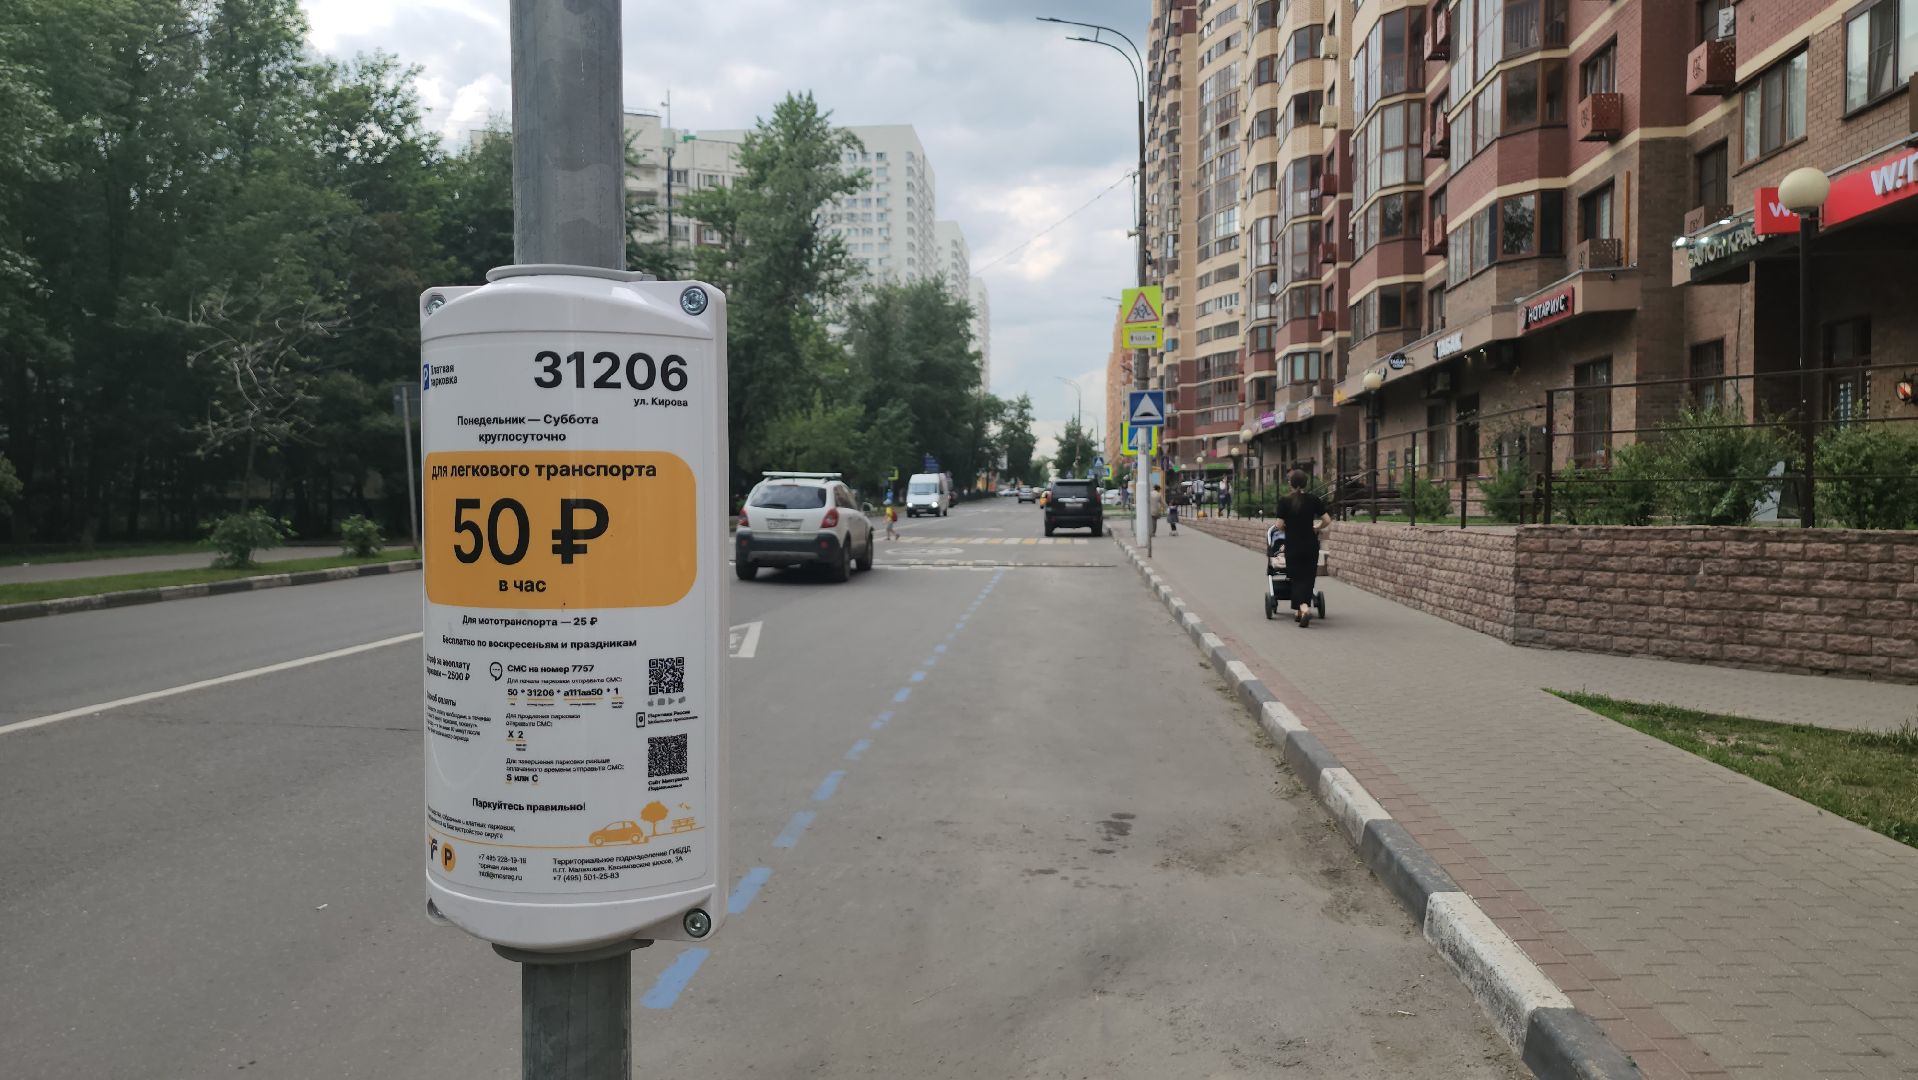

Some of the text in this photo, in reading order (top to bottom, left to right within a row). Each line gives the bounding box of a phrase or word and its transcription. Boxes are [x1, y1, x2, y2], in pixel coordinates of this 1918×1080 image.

[1528, 294, 1567, 322] НОТАРИУС
[534, 350, 688, 392] 31206
[633, 397, 688, 408] ул. Кирова
[457, 415, 526, 427] Понедельник
[543, 414, 599, 426] Суббота
[479, 433, 566, 445] круглосуточно
[432, 464, 657, 480] для легкового транспорта
[454, 497, 530, 565] 50
[499, 580, 547, 592] в час
[462, 615, 477, 625] Для
[479, 618, 558, 628] мототранспорта
[573, 617, 587, 626] 25
[442, 634, 475, 647] Бесплатно
[477, 639, 487, 647] по
[489, 641, 558, 650] воскресеньям
[570, 640, 637, 651] праздникам
[507, 664, 527, 673] СМС
[540, 666, 570, 674] номер
[572, 664, 595, 672] 7757
[507, 688, 518, 696] 50
[526, 688, 555, 697] 31206
[614, 687, 619, 695] 1
[517, 730, 524, 739] 2
[472, 797, 586, 813] Паркуйтесь правильно!
